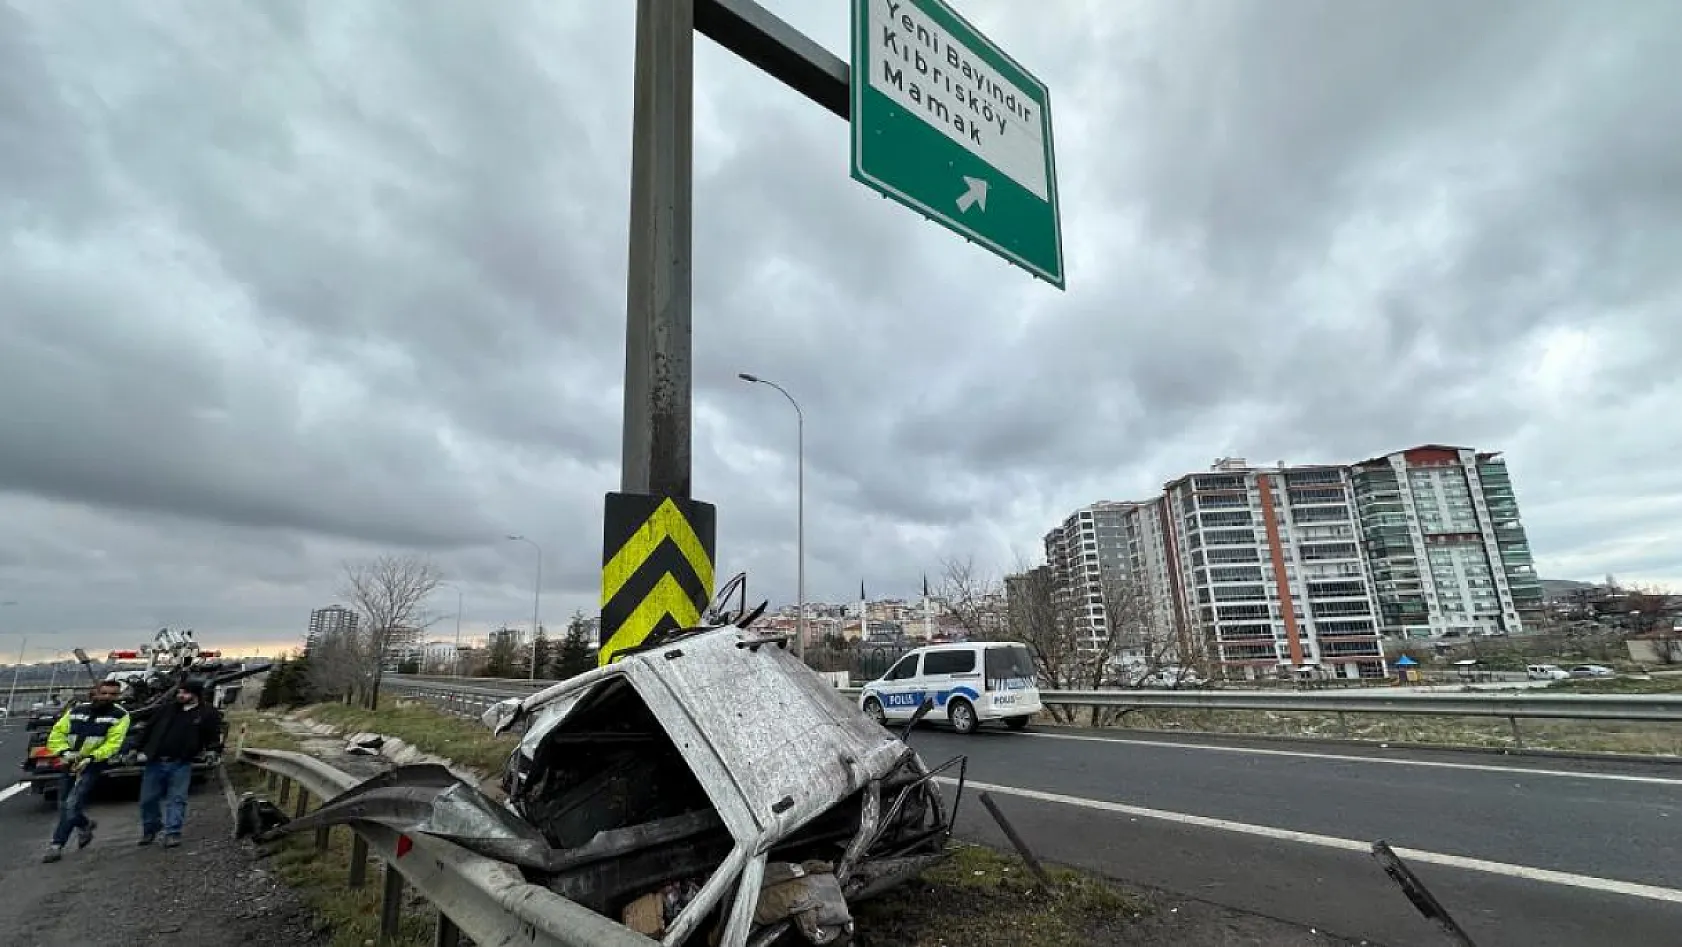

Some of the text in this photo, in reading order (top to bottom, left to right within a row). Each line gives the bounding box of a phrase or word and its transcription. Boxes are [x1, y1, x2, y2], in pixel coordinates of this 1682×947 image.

[884, 25, 1007, 135] Kıbrısköy
[884, 60, 981, 146] Mamak
[887, 0, 1031, 122] Yeni Bayındır
